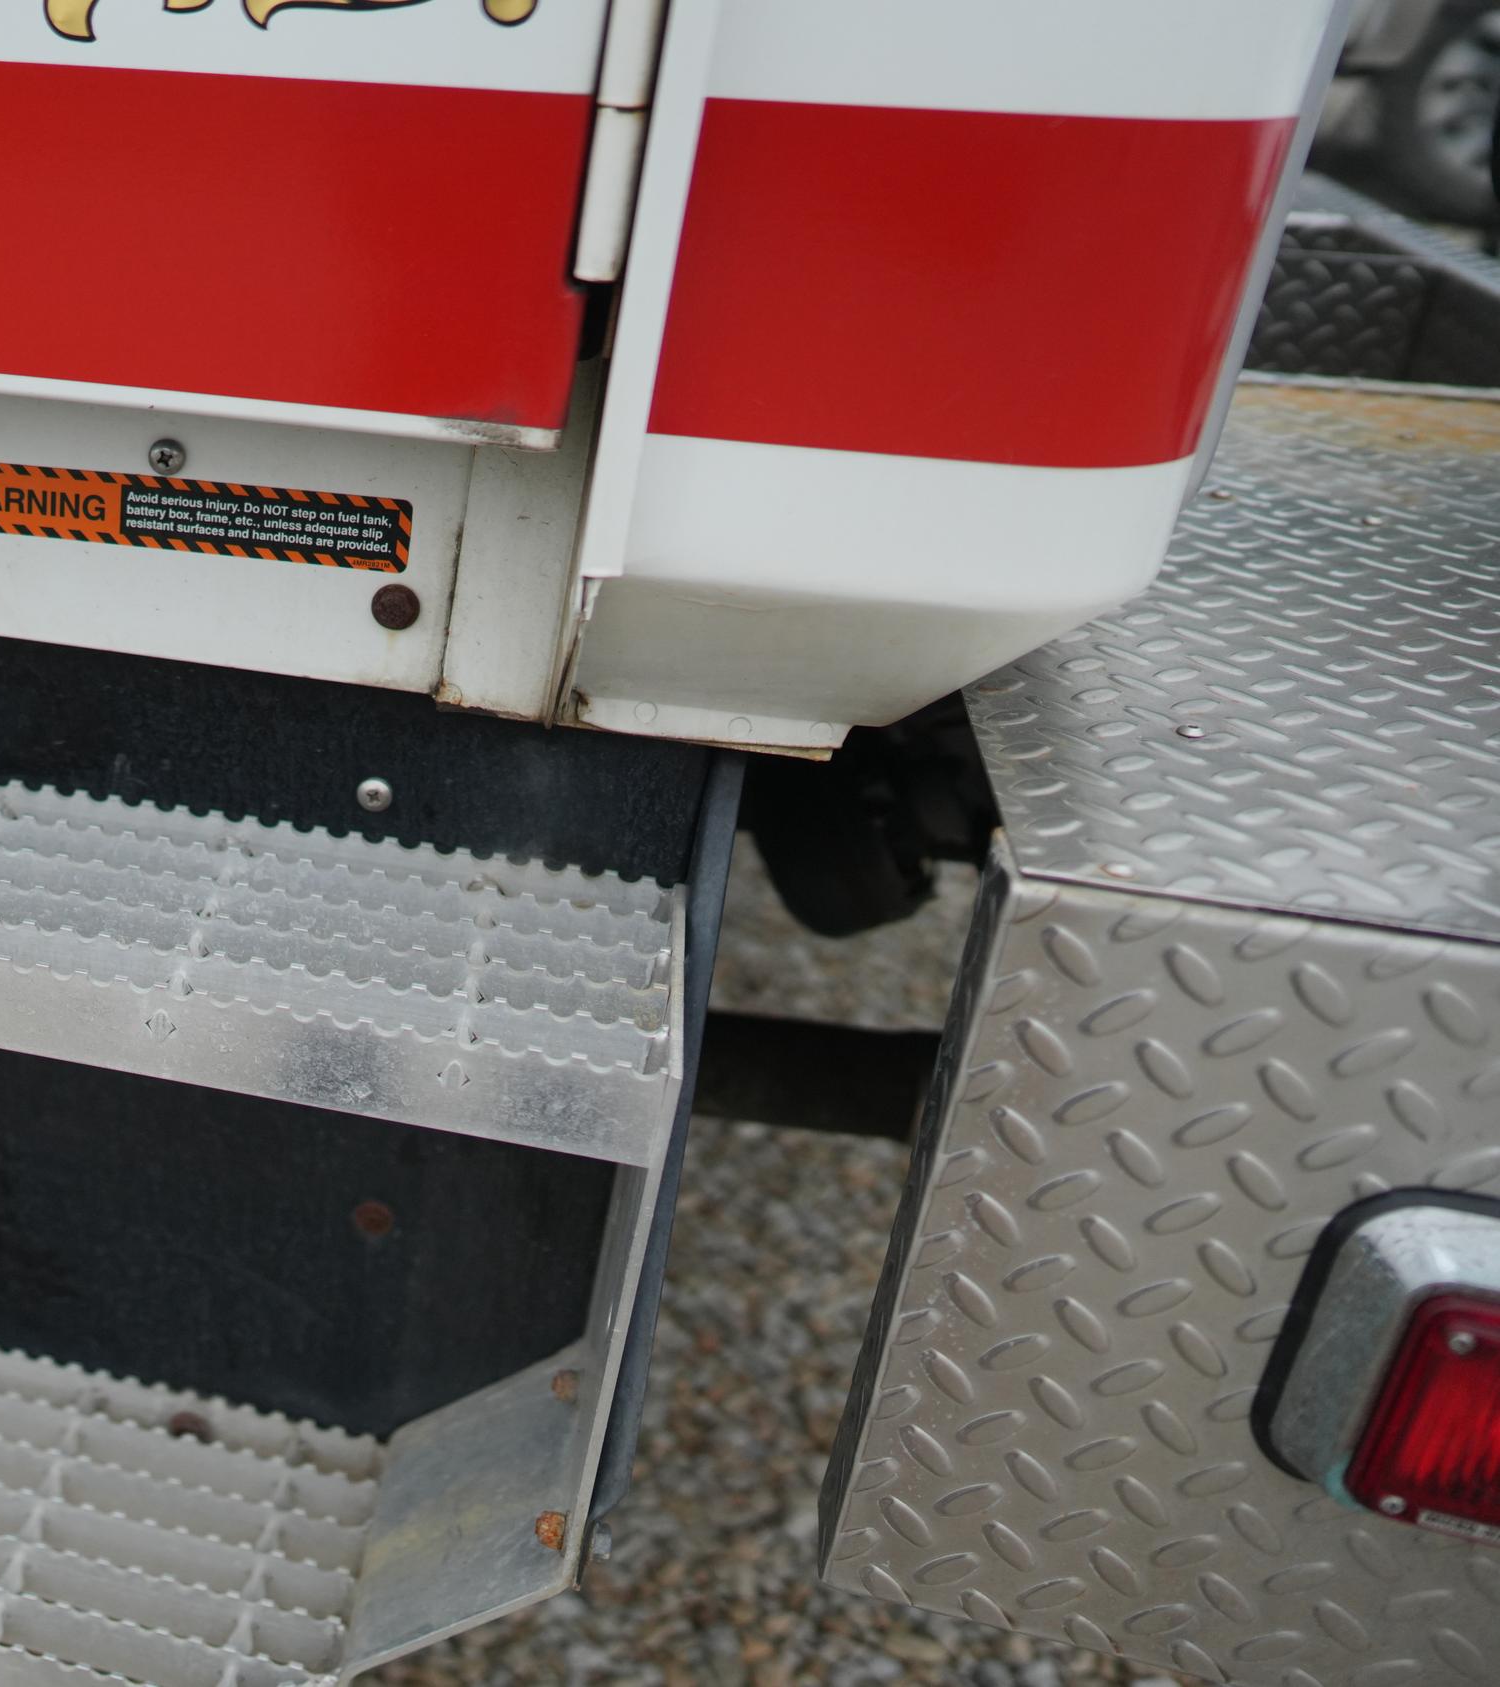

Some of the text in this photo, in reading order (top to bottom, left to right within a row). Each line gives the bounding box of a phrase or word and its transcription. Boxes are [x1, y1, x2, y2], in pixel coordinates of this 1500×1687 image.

[126, 505, 383, 541] battery box, frame, etc., unless adequate slip
[127, 491, 392, 528] Avoid serious injury. Do NOT step on fuel tank,
[126, 518, 392, 554] resistant surfaces and handholds are provided.
